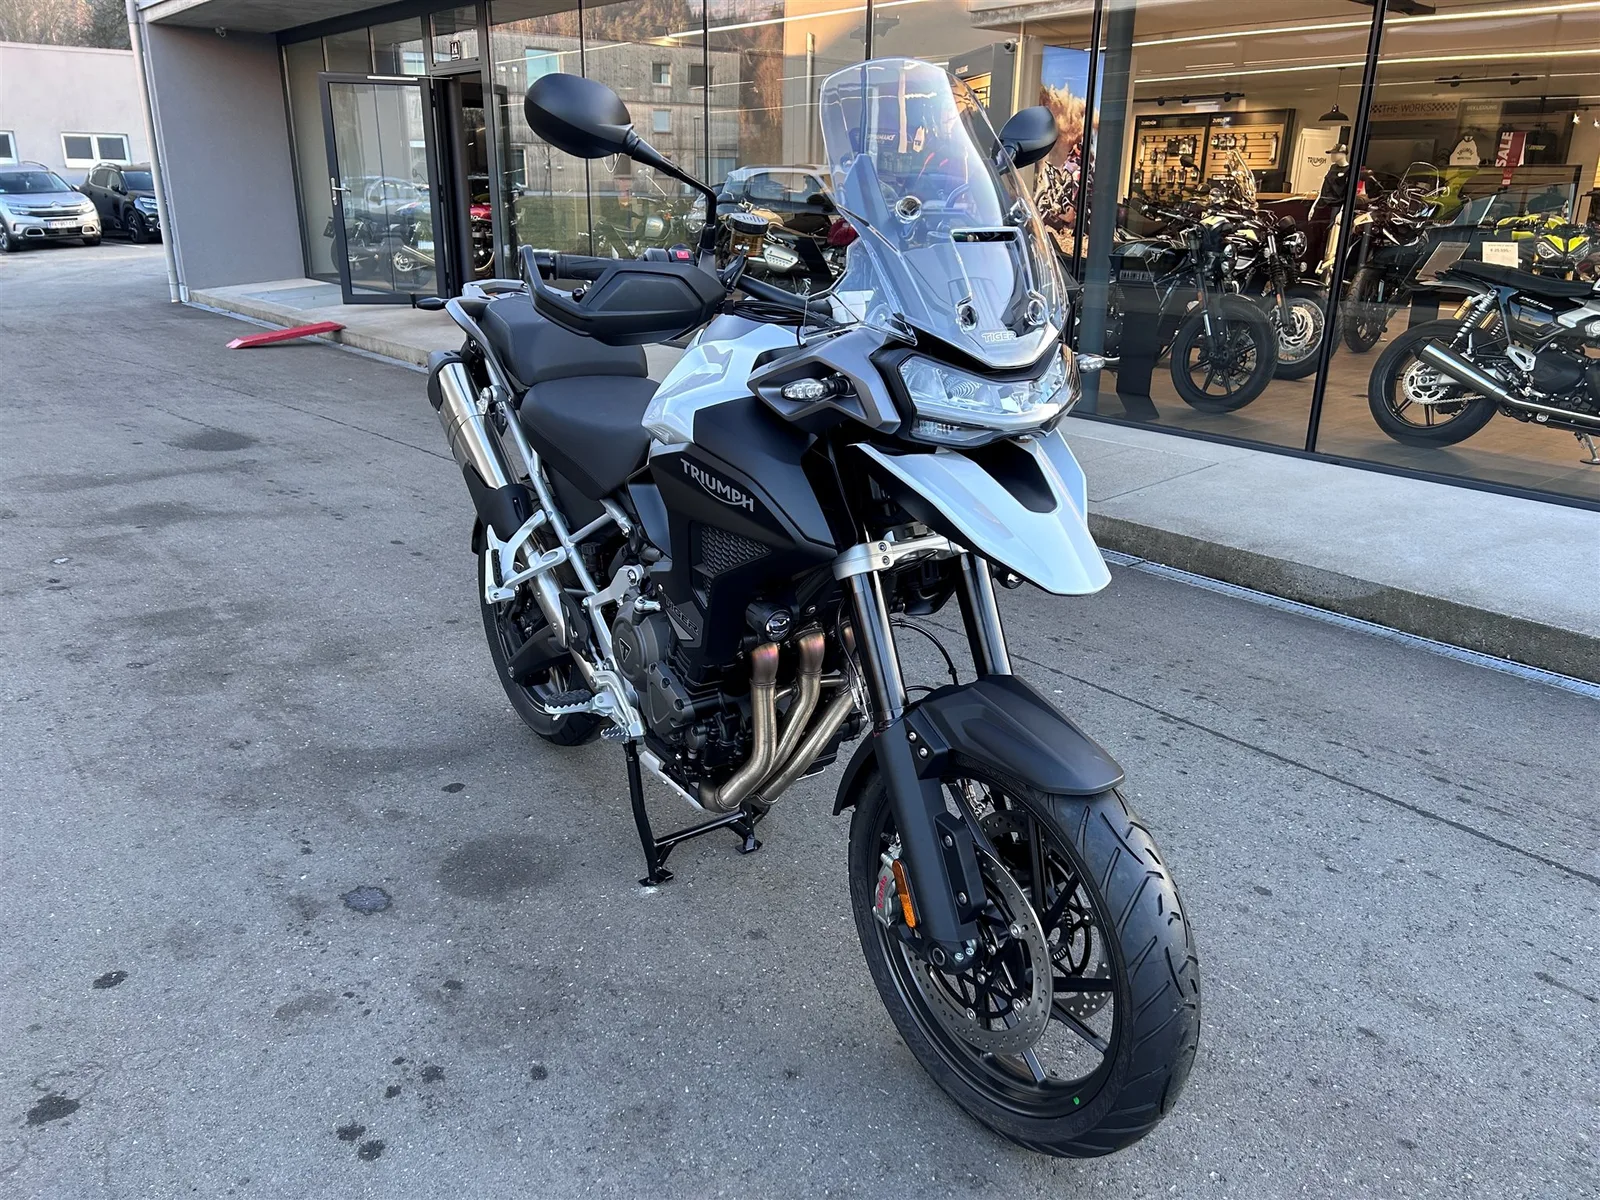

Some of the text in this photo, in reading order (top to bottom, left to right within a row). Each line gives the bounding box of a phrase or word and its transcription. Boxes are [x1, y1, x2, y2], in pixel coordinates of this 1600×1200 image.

[1383, 102, 1432, 113] THE WORKS
[1494, 131, 1514, 167] SALE
[981, 331, 1017, 343] TIGER
[680, 458, 754, 512] TRIUMPH
[664, 593, 699, 636] TIGER
